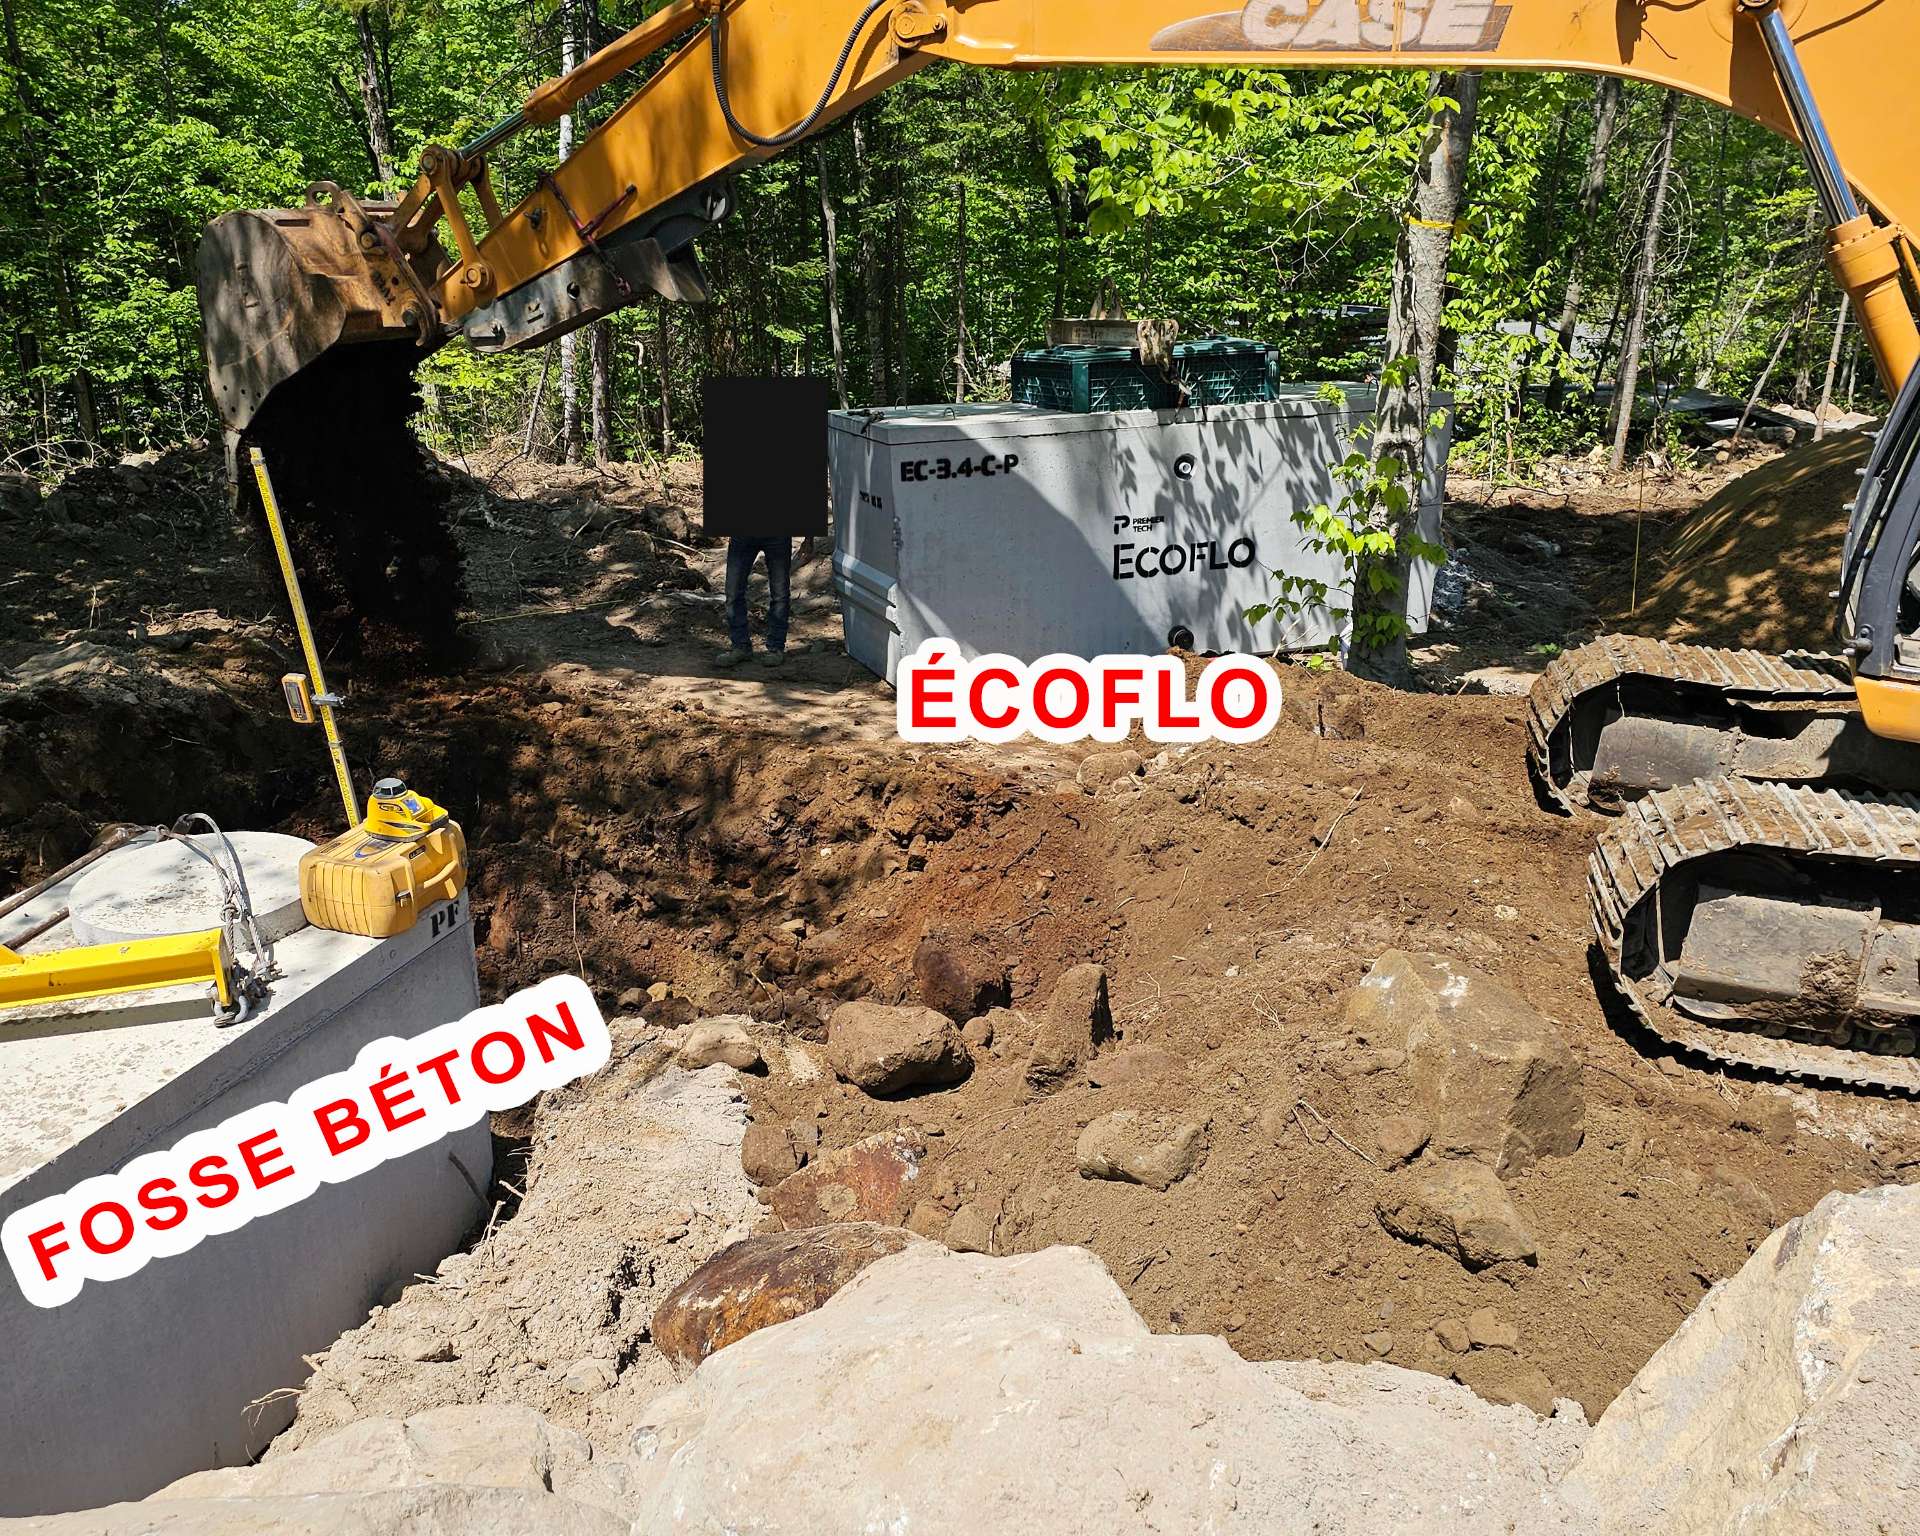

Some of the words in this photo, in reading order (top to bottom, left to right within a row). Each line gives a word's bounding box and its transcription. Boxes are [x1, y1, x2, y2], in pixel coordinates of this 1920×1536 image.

[1240, 0, 1496, 47] CASE
[900, 454, 1019, 482] EC-3.4-C-P
[1132, 525, 1153, 533] TECH
[1113, 537, 1256, 580] ECOFLO
